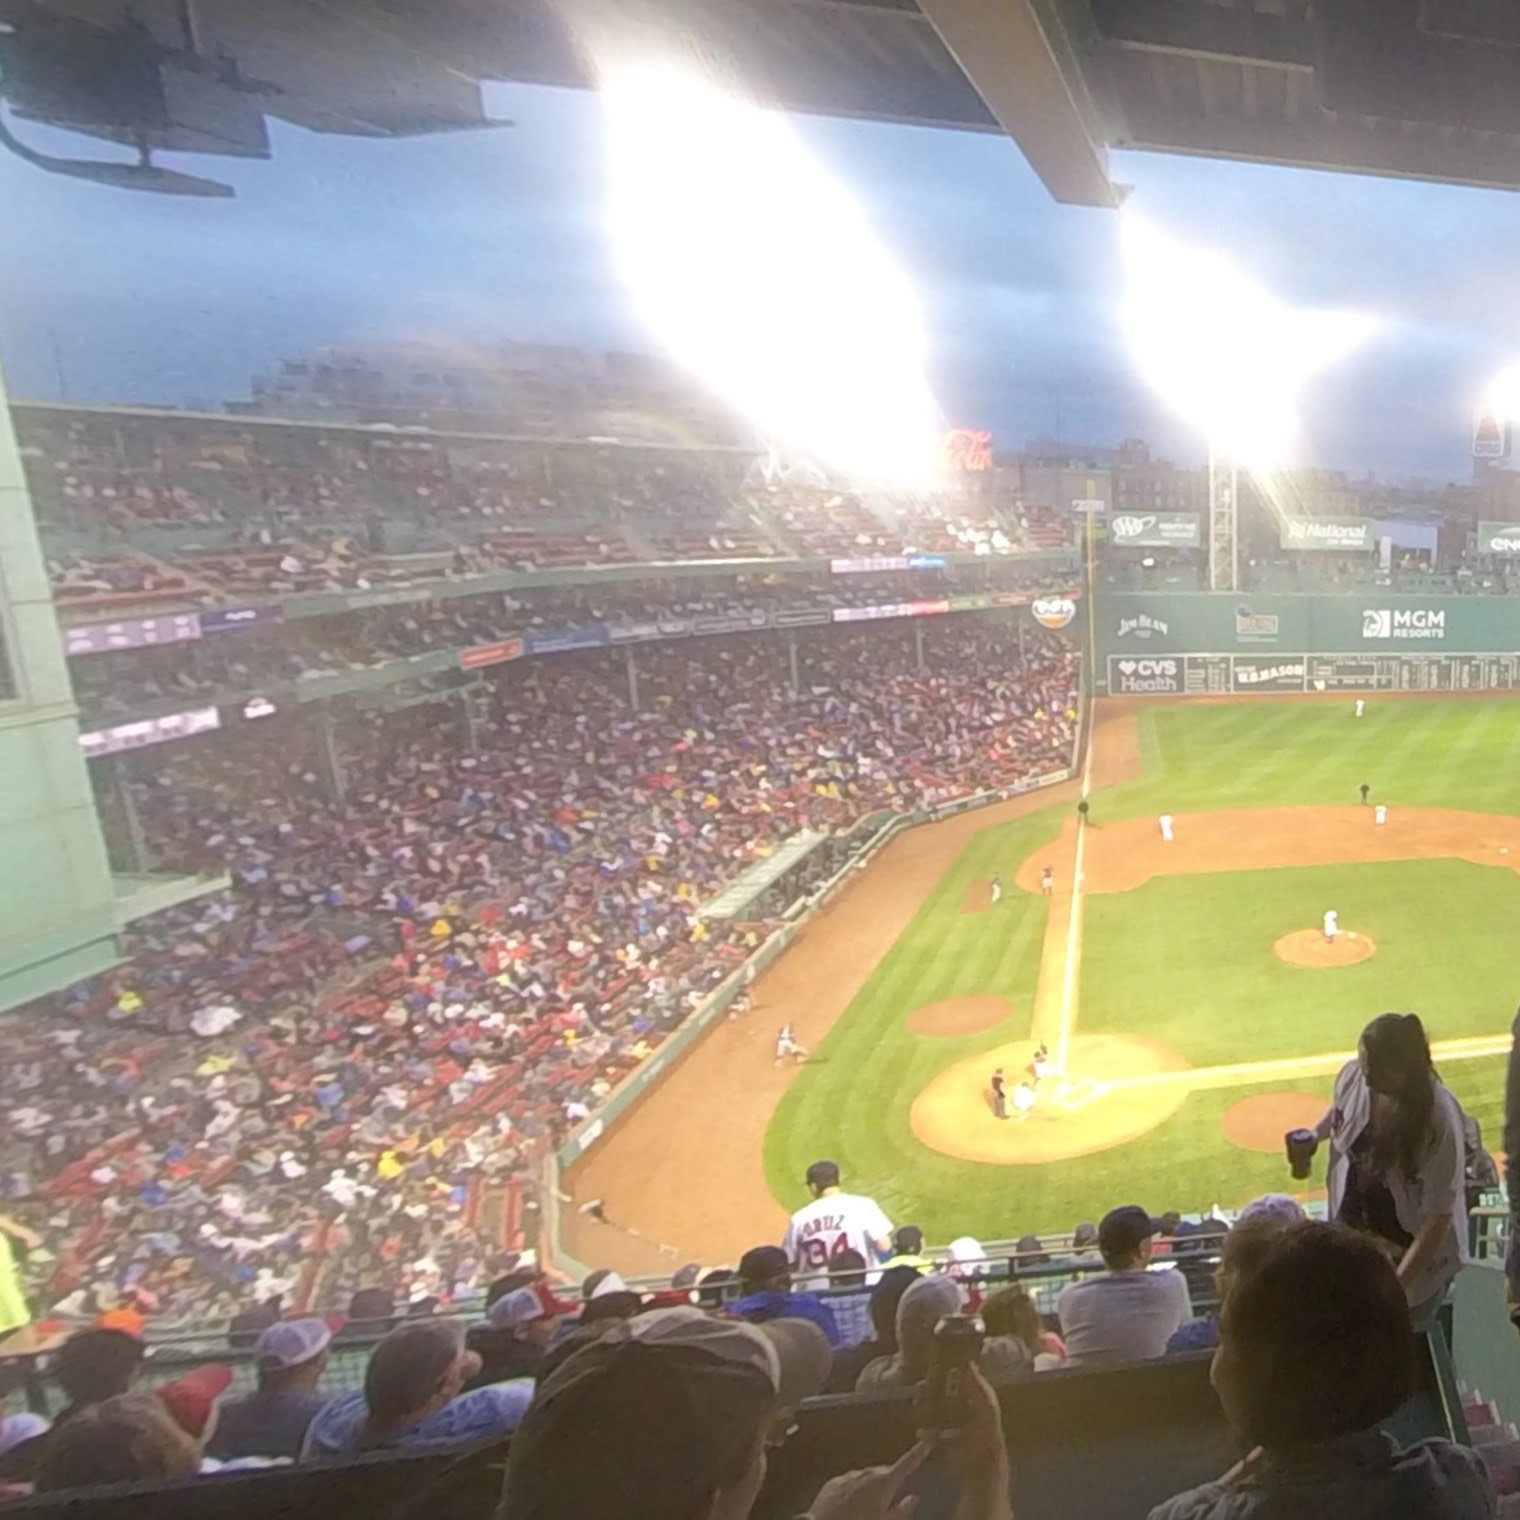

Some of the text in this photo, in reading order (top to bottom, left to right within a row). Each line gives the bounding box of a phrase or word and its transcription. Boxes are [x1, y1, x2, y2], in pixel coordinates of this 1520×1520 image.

[1306, 524, 1367, 538] National
[1393, 610, 1445, 627] MGM
[1393, 628, 1444, 638] RESORTS
[1137, 660, 1177, 676] CVS
[1120, 676, 1177, 692] Health
[803, 1215, 843, 1236] ORTIZ
[803, 1232, 849, 1268] 34
